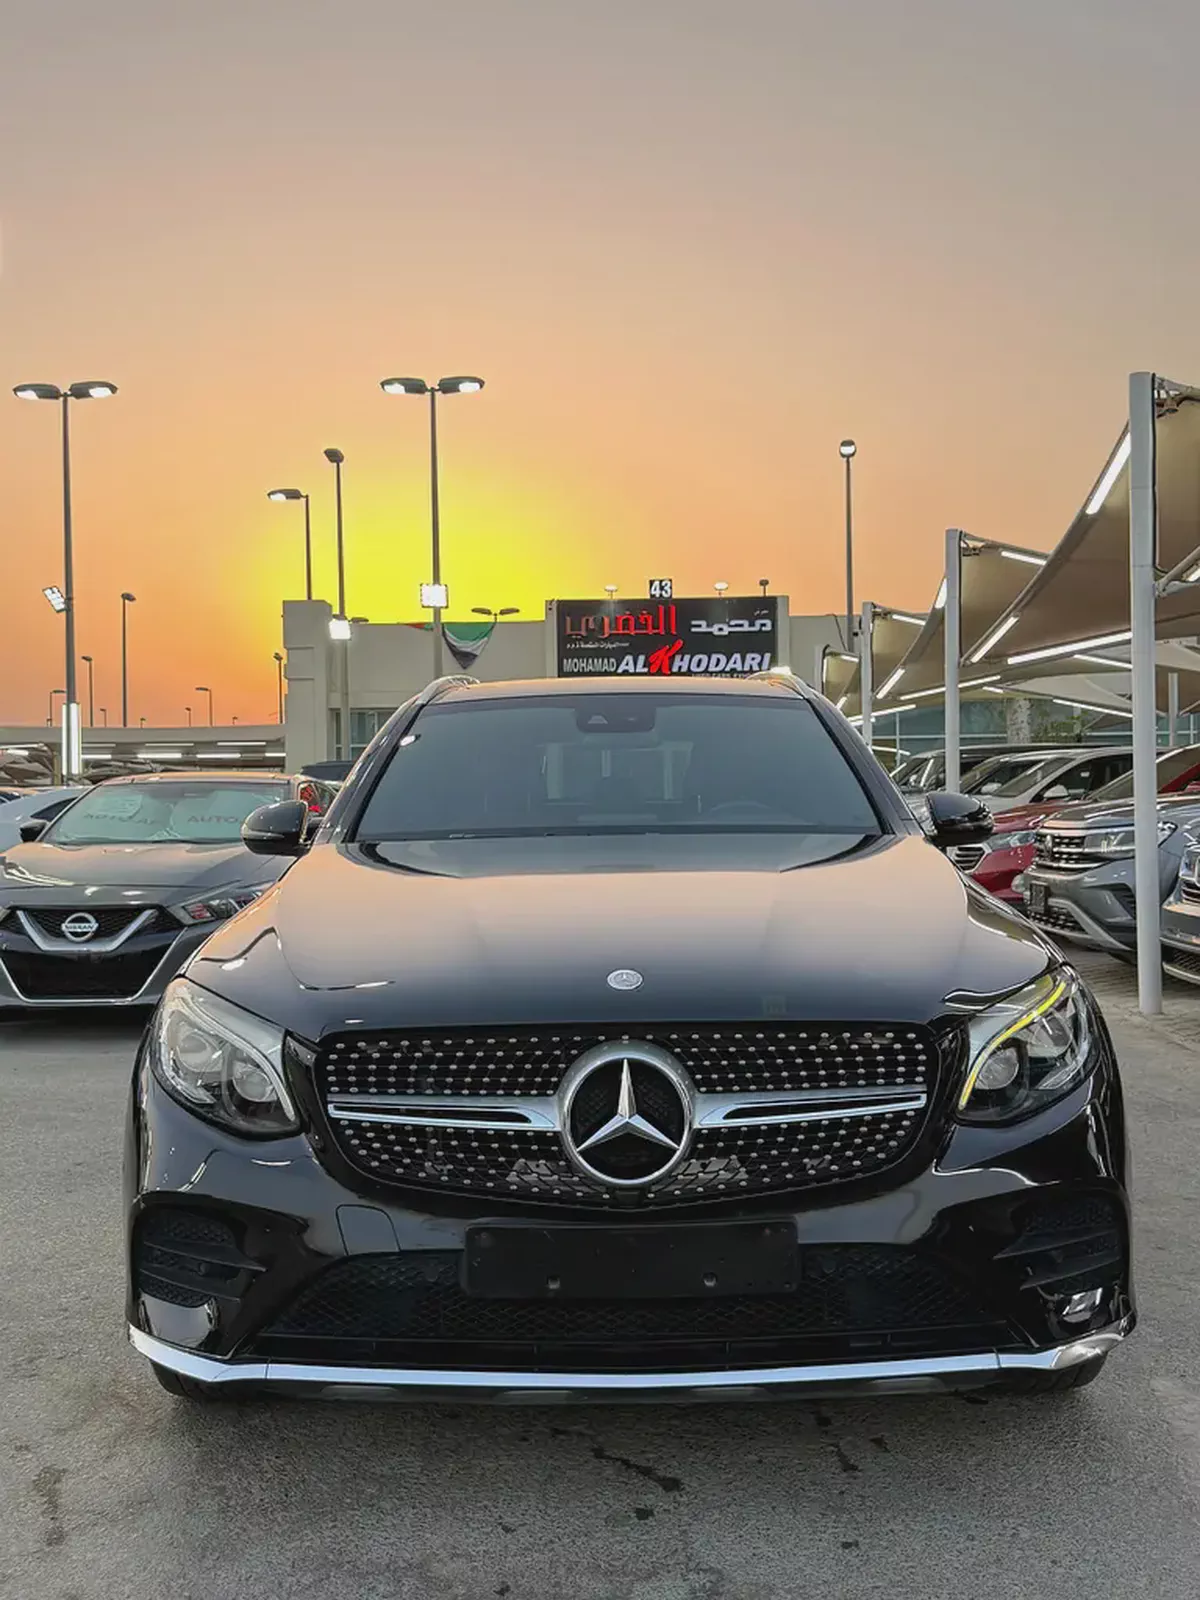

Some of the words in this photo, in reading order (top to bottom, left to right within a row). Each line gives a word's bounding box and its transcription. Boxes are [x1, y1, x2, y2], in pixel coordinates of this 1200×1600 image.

[650, 580, 672, 598] 43
[565, 604, 677, 639] الخضري
[691, 619, 772, 636] محمد
[563, 657, 617, 673] MOHAMAD
[187, 814, 239, 824] AUTO
